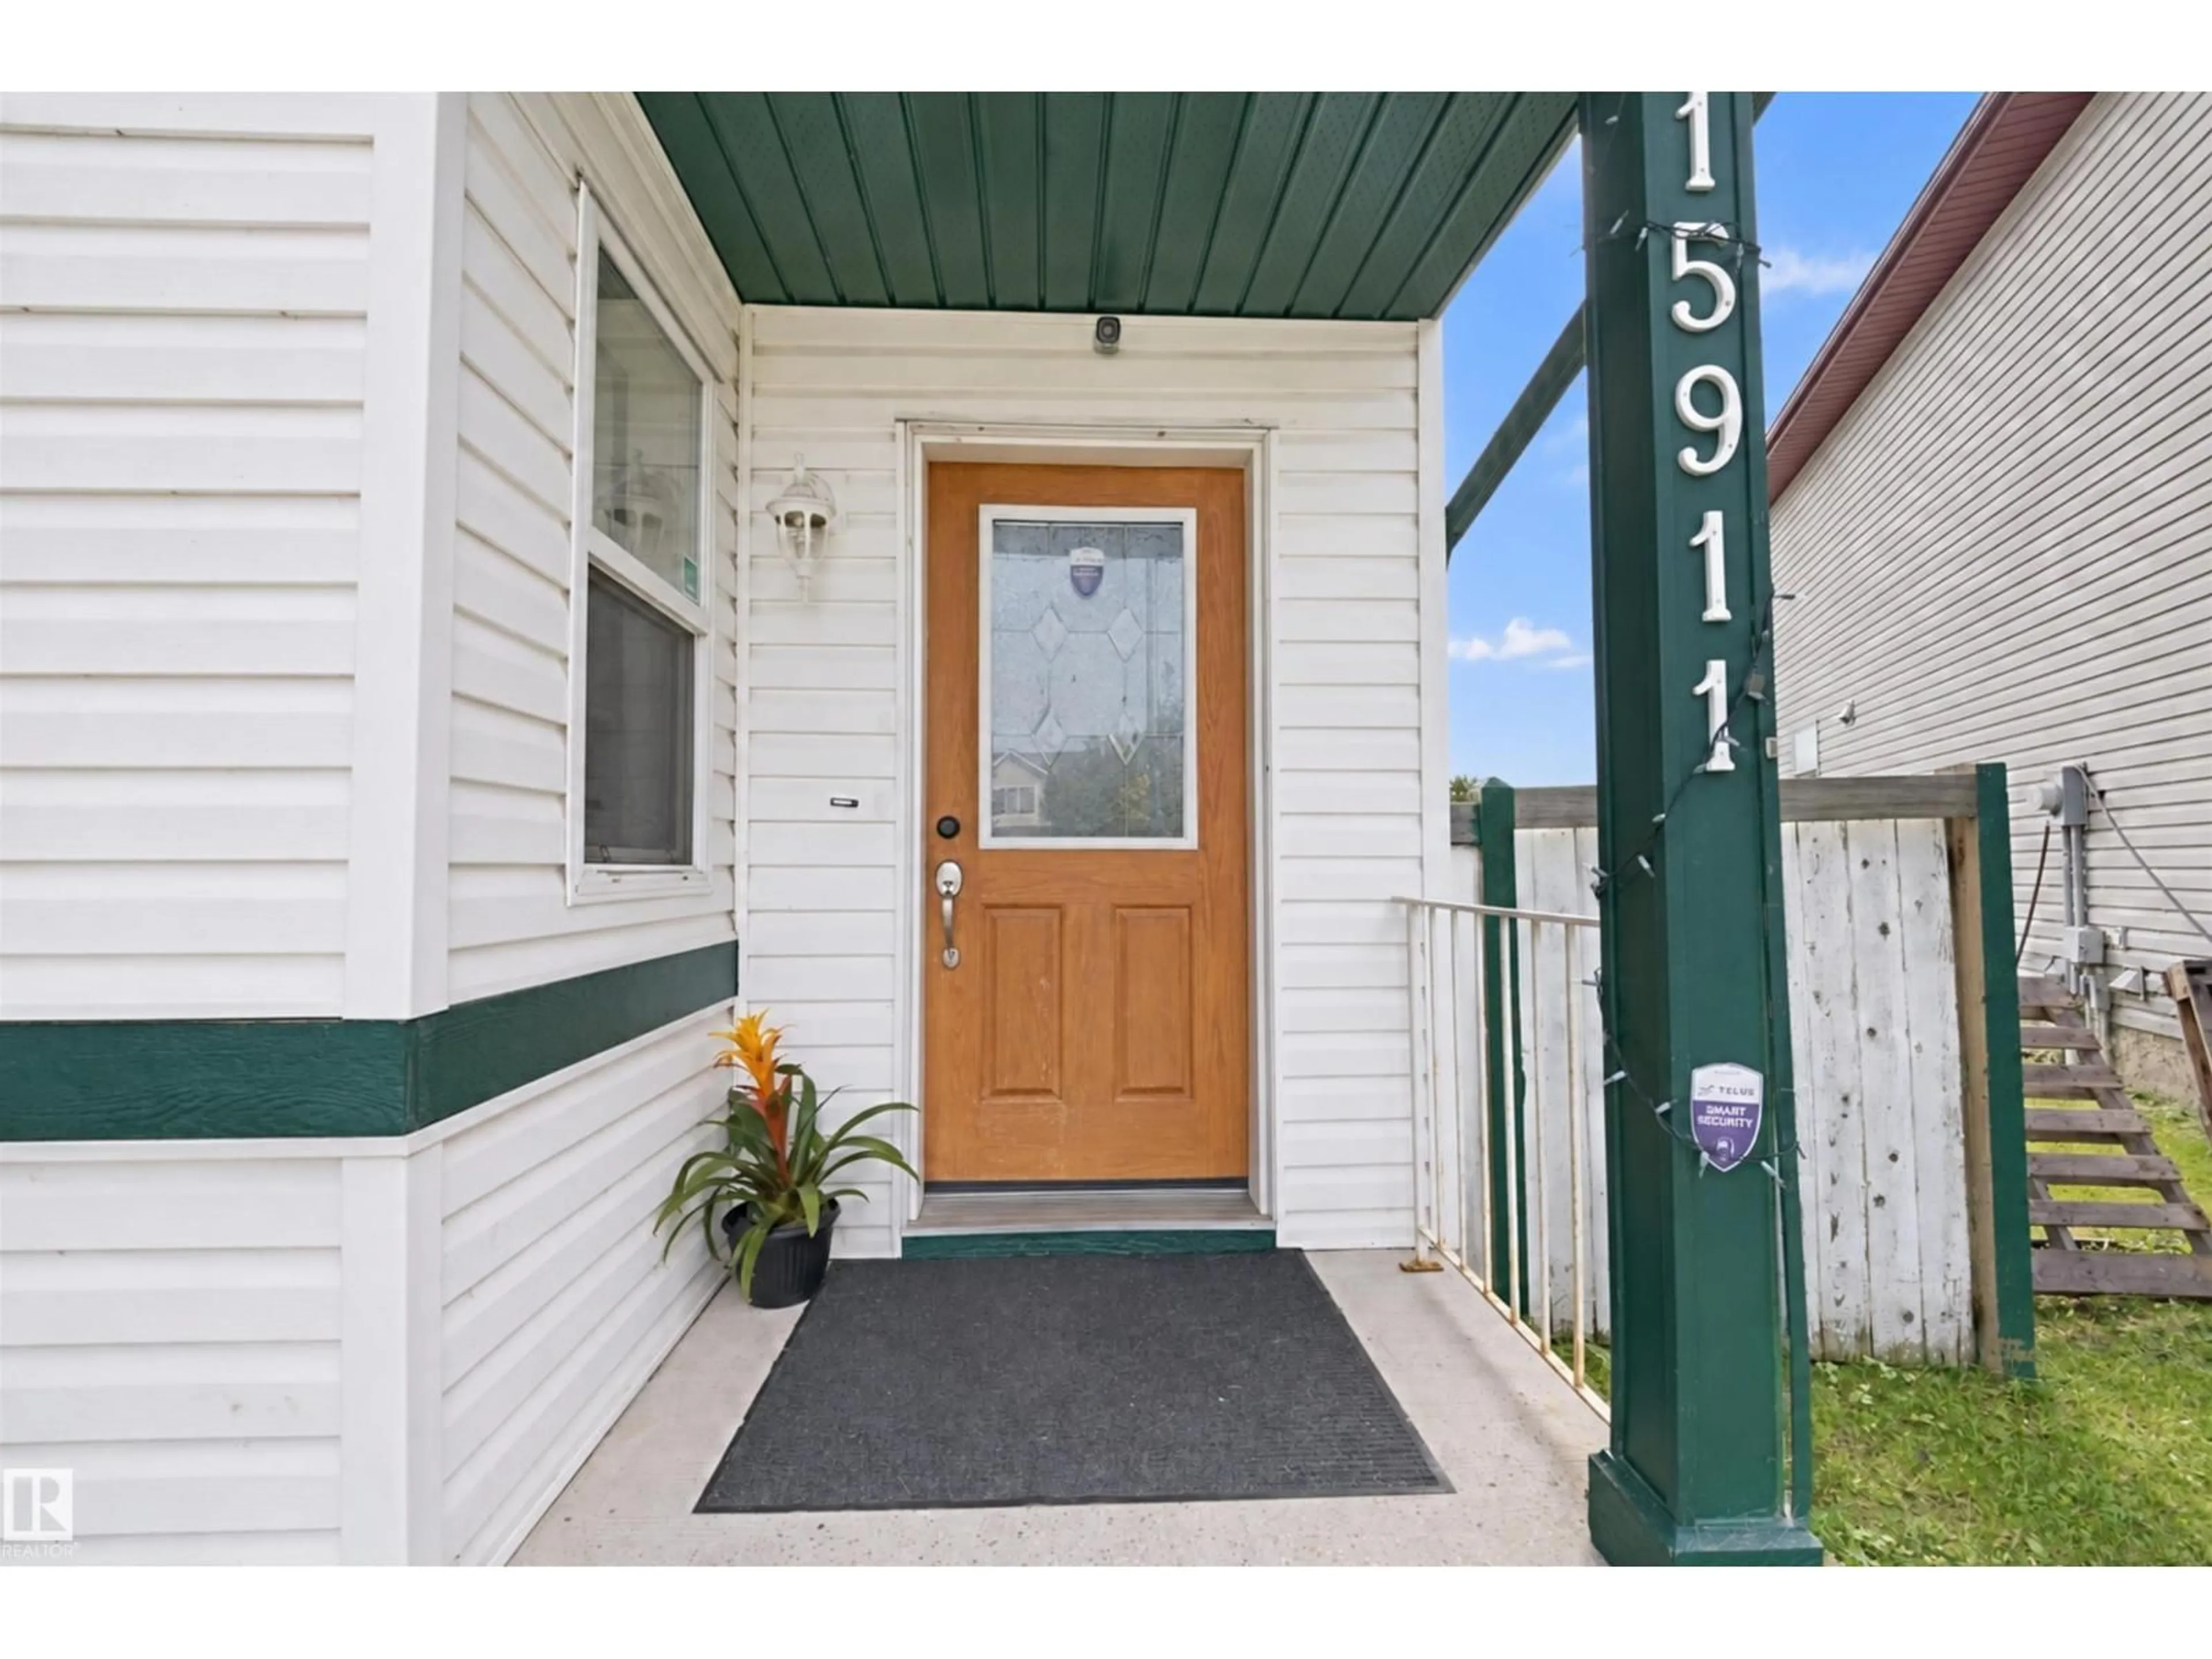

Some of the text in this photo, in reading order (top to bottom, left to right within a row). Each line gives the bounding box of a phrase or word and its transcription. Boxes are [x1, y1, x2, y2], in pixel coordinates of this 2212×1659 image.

[1671, 92, 1743, 771] 15911
[1719, 1086, 1755, 1096] TELUS
[1706, 1105, 1747, 1116] SMART
[1698, 1115, 1754, 1128] SECURITY
